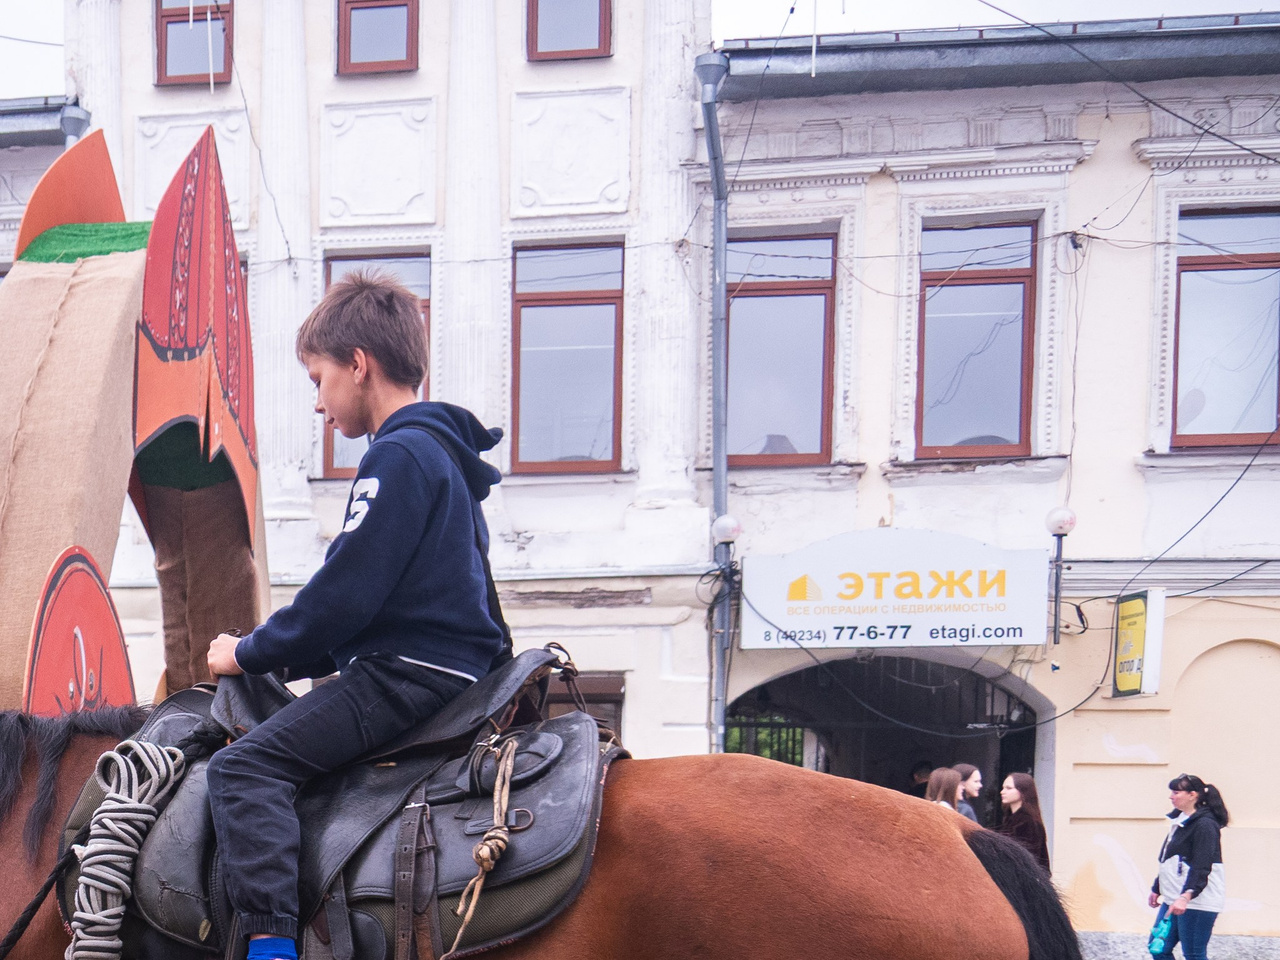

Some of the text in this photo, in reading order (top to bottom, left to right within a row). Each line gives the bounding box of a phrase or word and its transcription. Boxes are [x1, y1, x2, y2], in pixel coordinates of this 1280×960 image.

[836, 569, 1007, 600] этажи
[787, 603, 1007, 616] ВСЕ ОПЕРАЦИИ С НЕДВИЖИМОСТЬЮ
[763, 624, 1023, 643] 8 (49234) 77-6-77 etagi.com
